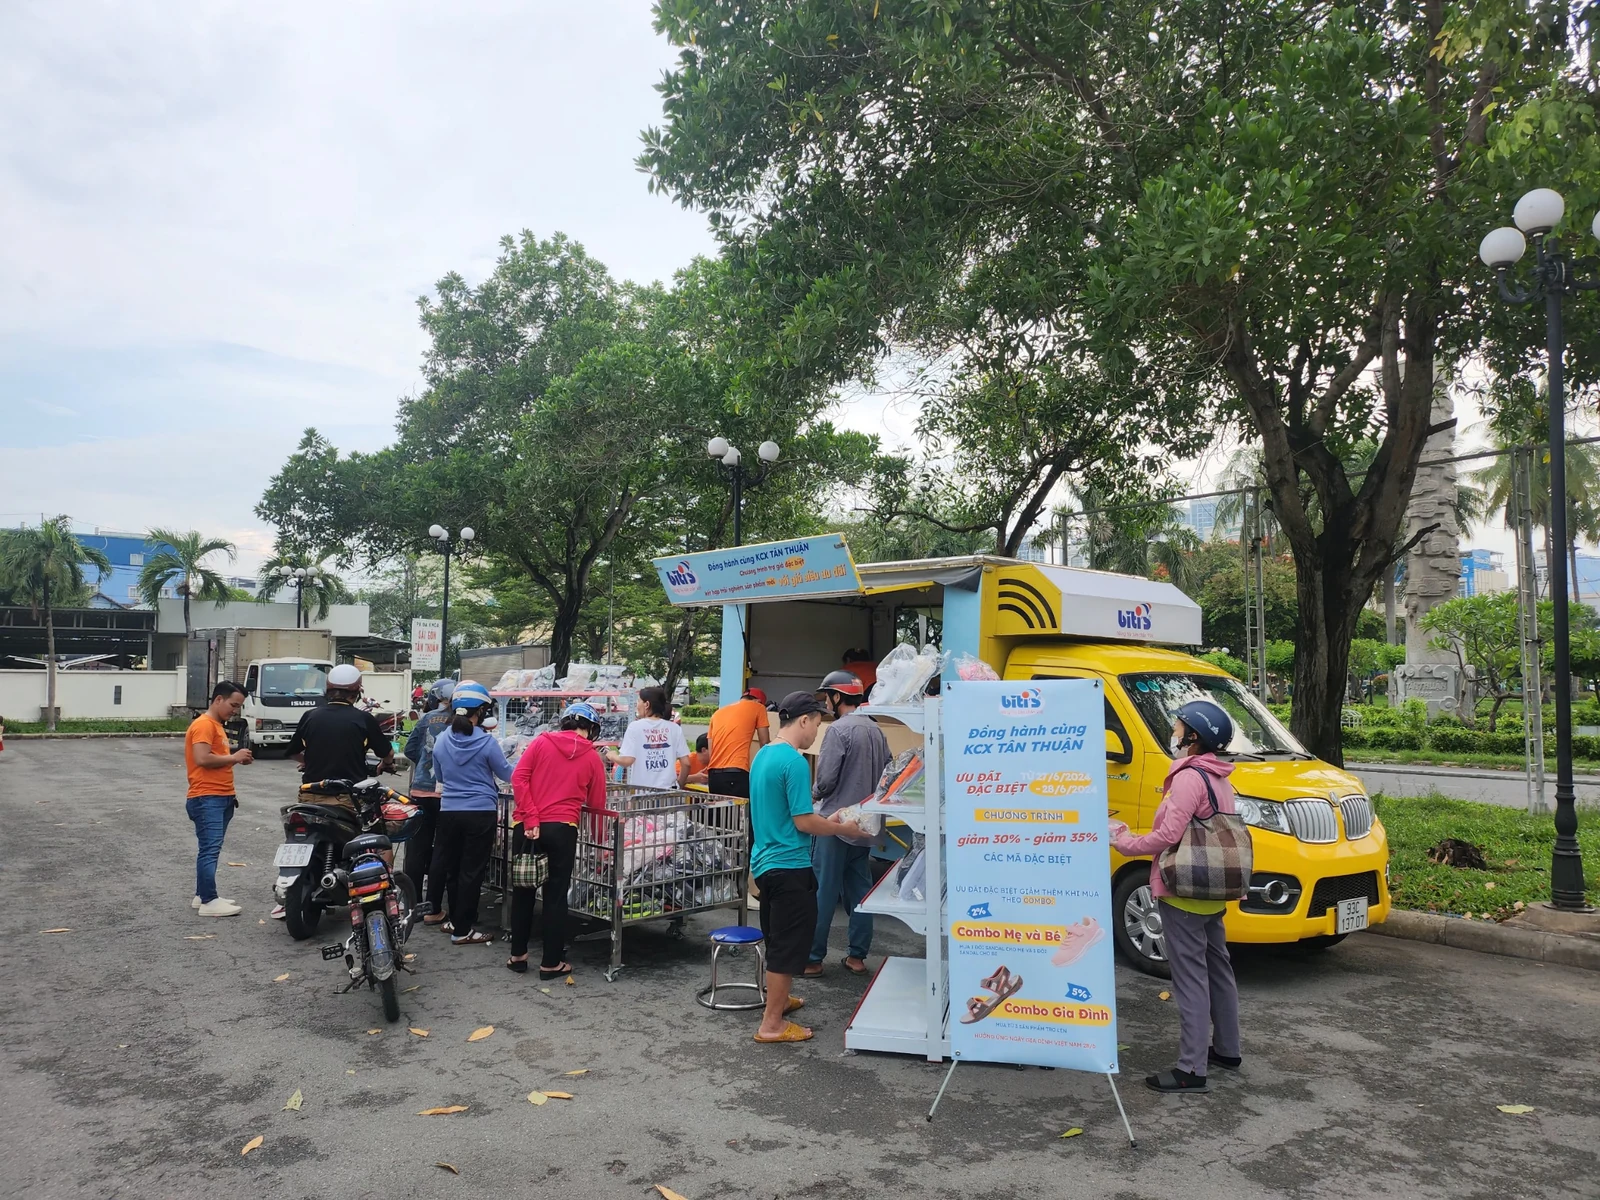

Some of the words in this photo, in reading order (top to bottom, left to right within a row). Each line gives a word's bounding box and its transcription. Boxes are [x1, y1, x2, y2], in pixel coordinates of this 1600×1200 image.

[708, 561, 723, 571] Đồng
[724, 558, 739, 568] hành
[740, 556, 755, 565] cùng
[755, 551, 769, 561] KCX
[769, 547, 783, 558] TÂN
[785, 541, 809, 554] THUẬN
[968, 725, 1006, 740] Đồng
[1010, 725, 1047, 737] hành
[1051, 723, 1087, 737] cùng
[963, 743, 993, 755] KCX
[998, 740, 1027, 754] TÂN
[1031, 737, 1084, 754] THUẬN
[956, 773, 974, 783] ƯU
[977, 770, 1002, 782] ĐÃI
[967, 783, 992, 797] ĐẶC
[995, 782, 1027, 796] BIỆT
[984, 811, 1027, 820] CHƯƠNG
[1030, 811, 1063, 821] TRÌNH
[957, 834, 989, 847] giảm
[993, 834, 1020, 845] 30%
[1033, 832, 1066, 845] giảm
[1070, 832, 1098, 843] 35%
[984, 852, 1003, 862] CÁC
[1006, 853, 1021, 862] MÃ
[1024, 853, 1045, 865] ĐẶC
[1048, 854, 1072, 866] BIỆT
[984, 886, 999, 894] ĐẶC
[1001, 887, 1017, 895] BIỆT
[1020, 886, 1040, 895] GIẢM
[1042, 888, 1063, 896] THÊM
[1002, 896, 1022, 904] THEO
[971, 907, 986, 917] 2%
[1347, 901, 1360, 915] 93C
[957, 926, 1001, 938] Combo
[1004, 928, 1022, 943] Mẹ
[1026, 929, 1041, 941] và
[1045, 930, 1061, 942] Bé
[1072, 988, 1088, 999] 5%
[1004, 1002, 1049, 1016] Combo
[1052, 1006, 1075, 1019] Gia
[1079, 1008, 1109, 1021] Đình
